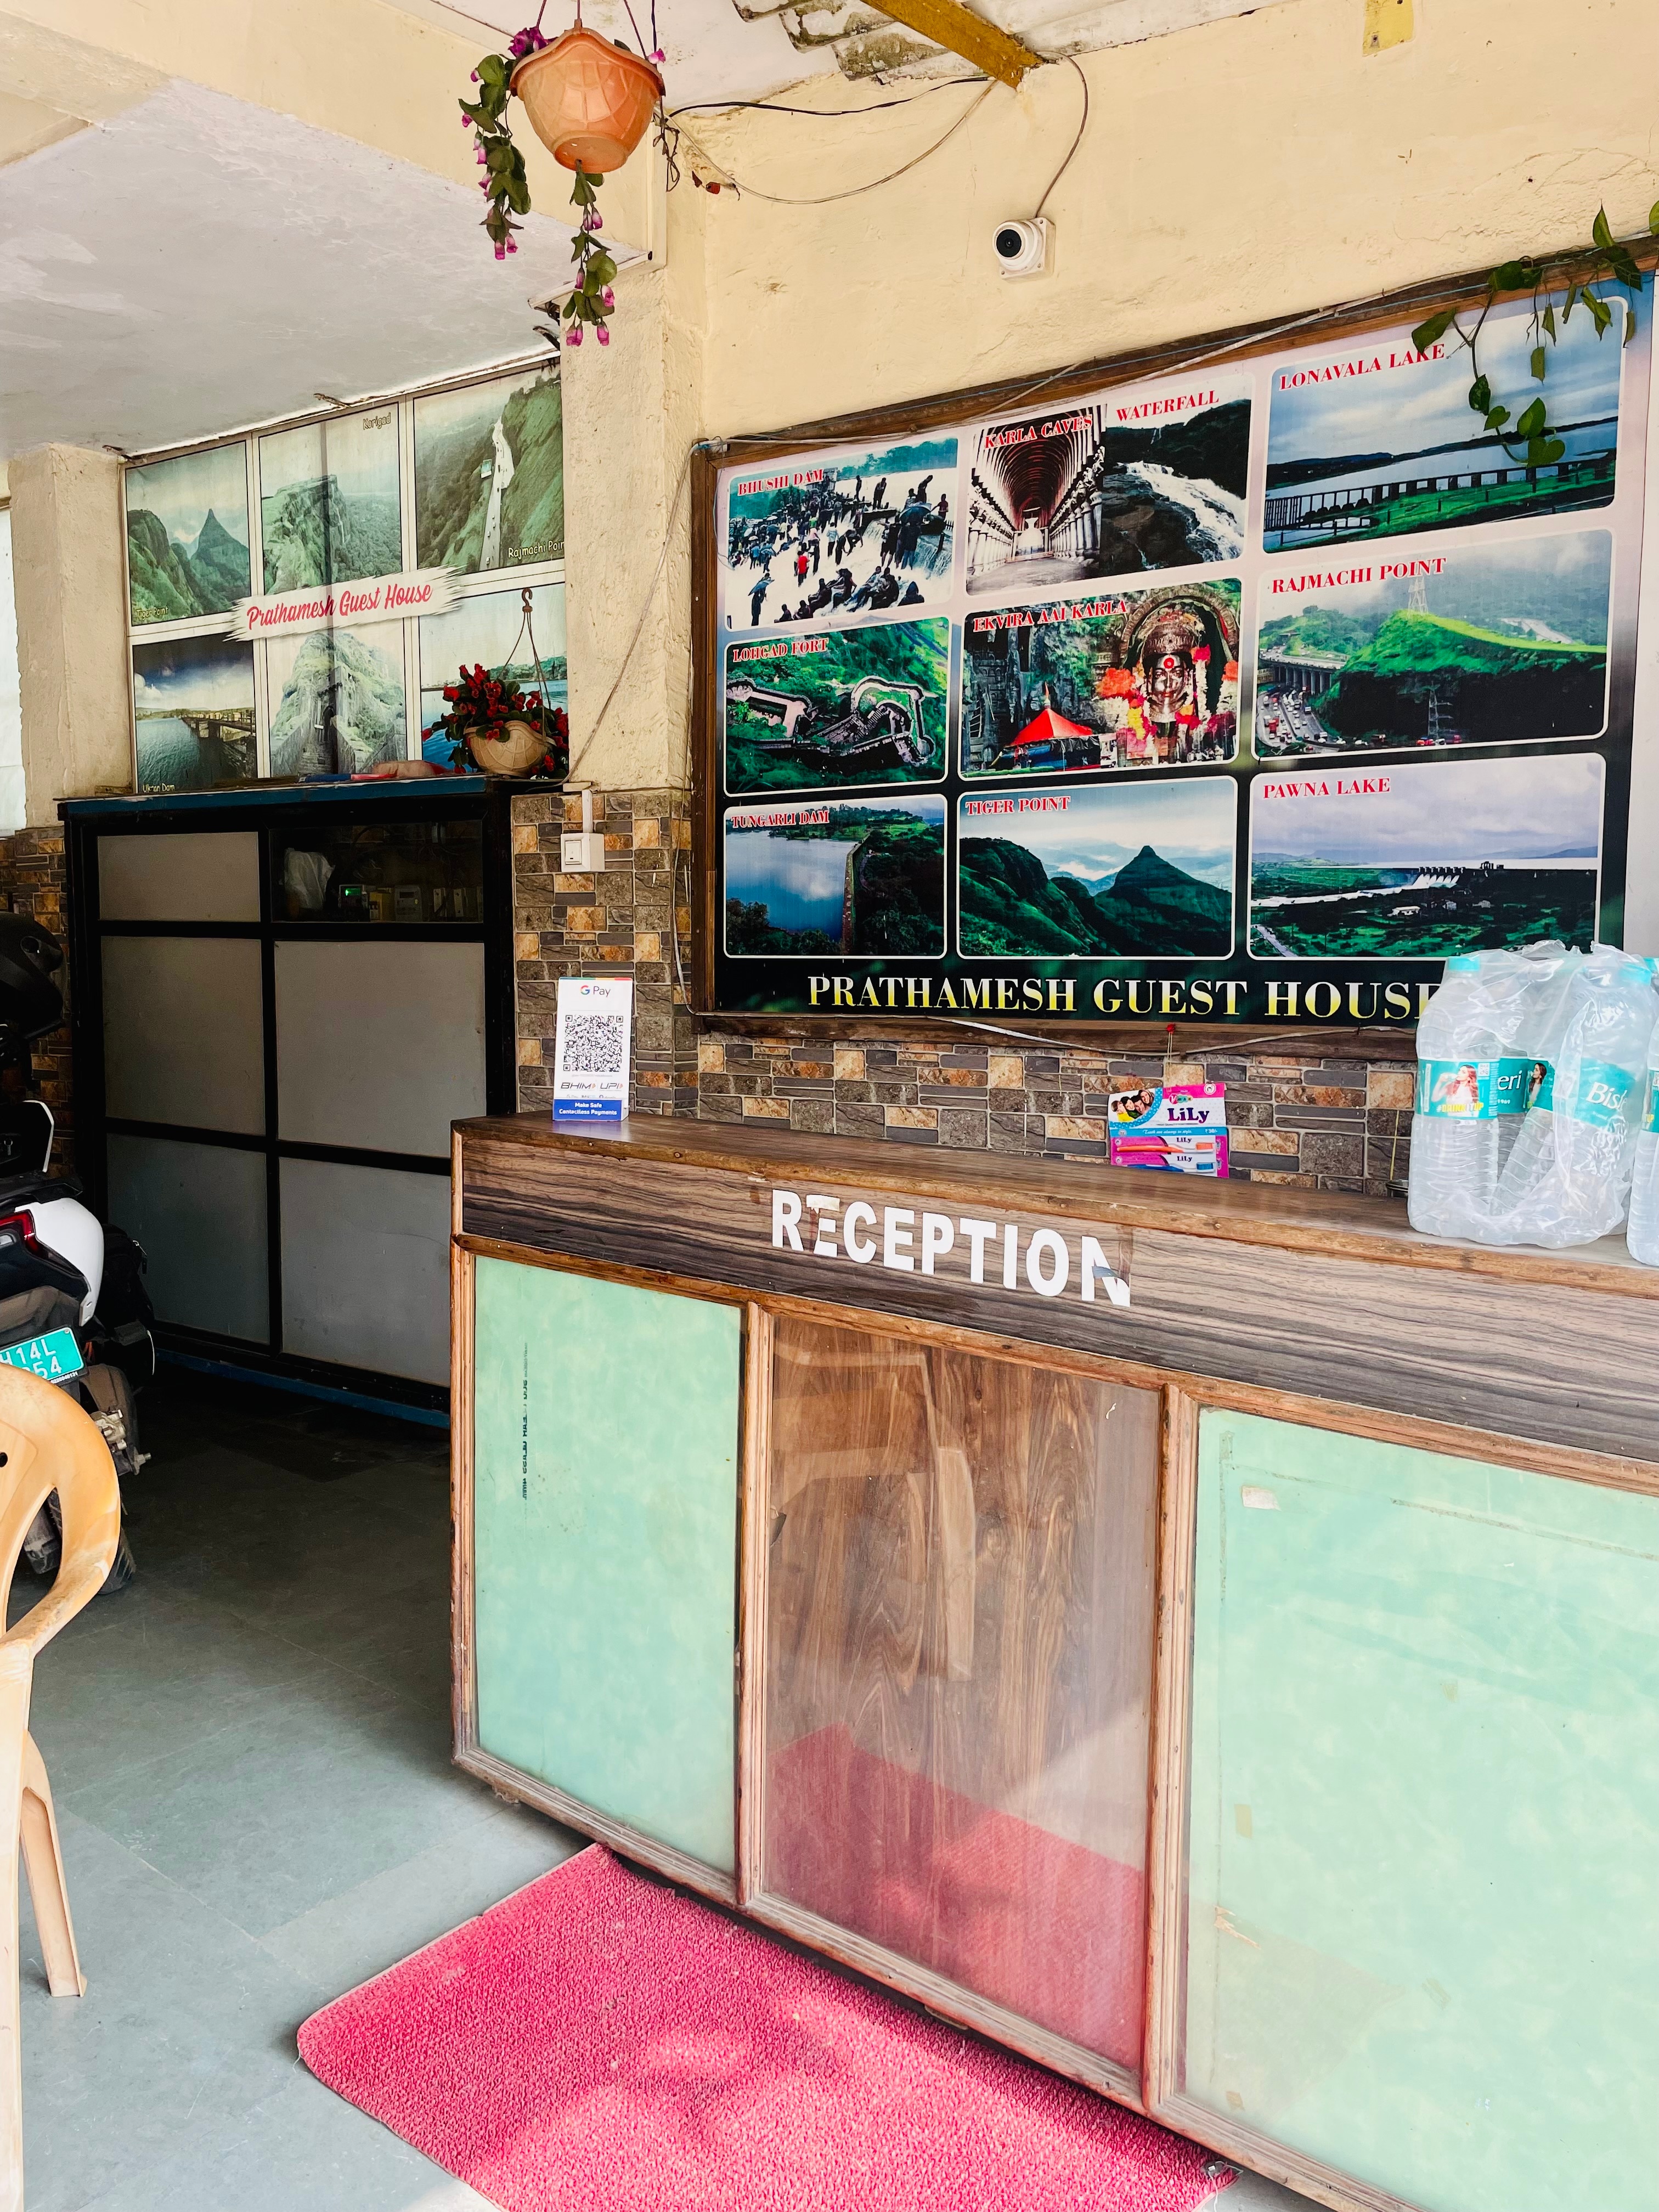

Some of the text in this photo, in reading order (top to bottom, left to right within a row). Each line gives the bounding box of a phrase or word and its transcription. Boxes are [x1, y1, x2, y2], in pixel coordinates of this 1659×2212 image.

[1280, 343, 1444, 390] LONAVALA LAKE
[1116, 390, 1219, 422] WATERFALL
[363, 412, 391, 431] Korigad
[985, 414, 1093, 449] KARLA CAVES
[738, 469, 823, 495] BHUSHI DAM
[508, 543, 545, 560] Rajmachi
[1272, 558, 1446, 594] RAJMACHI POINT
[136, 606, 168, 620] Tiger Point
[247, 584, 434, 630] Prathamesh Guest House
[974, 600, 1128, 632] EKVIRA AAI KARLA
[733, 639, 828, 662] LOHGAD FORT
[162, 783, 174, 792] Dam
[1263, 778, 1390, 799] PAWNA LAKE
[966, 796, 1070, 815] TIGER POINT
[731, 810, 830, 828] TUNGARLI DAM
[593, 986, 611, 997] Pay
[808, 975, 1077, 1011] PRATHAMESH
[1093, 979, 1247, 1015] GUEST
[772, 1189, 1131, 1307] RECEPTION
[22, 1356, 62, 1379] 54
